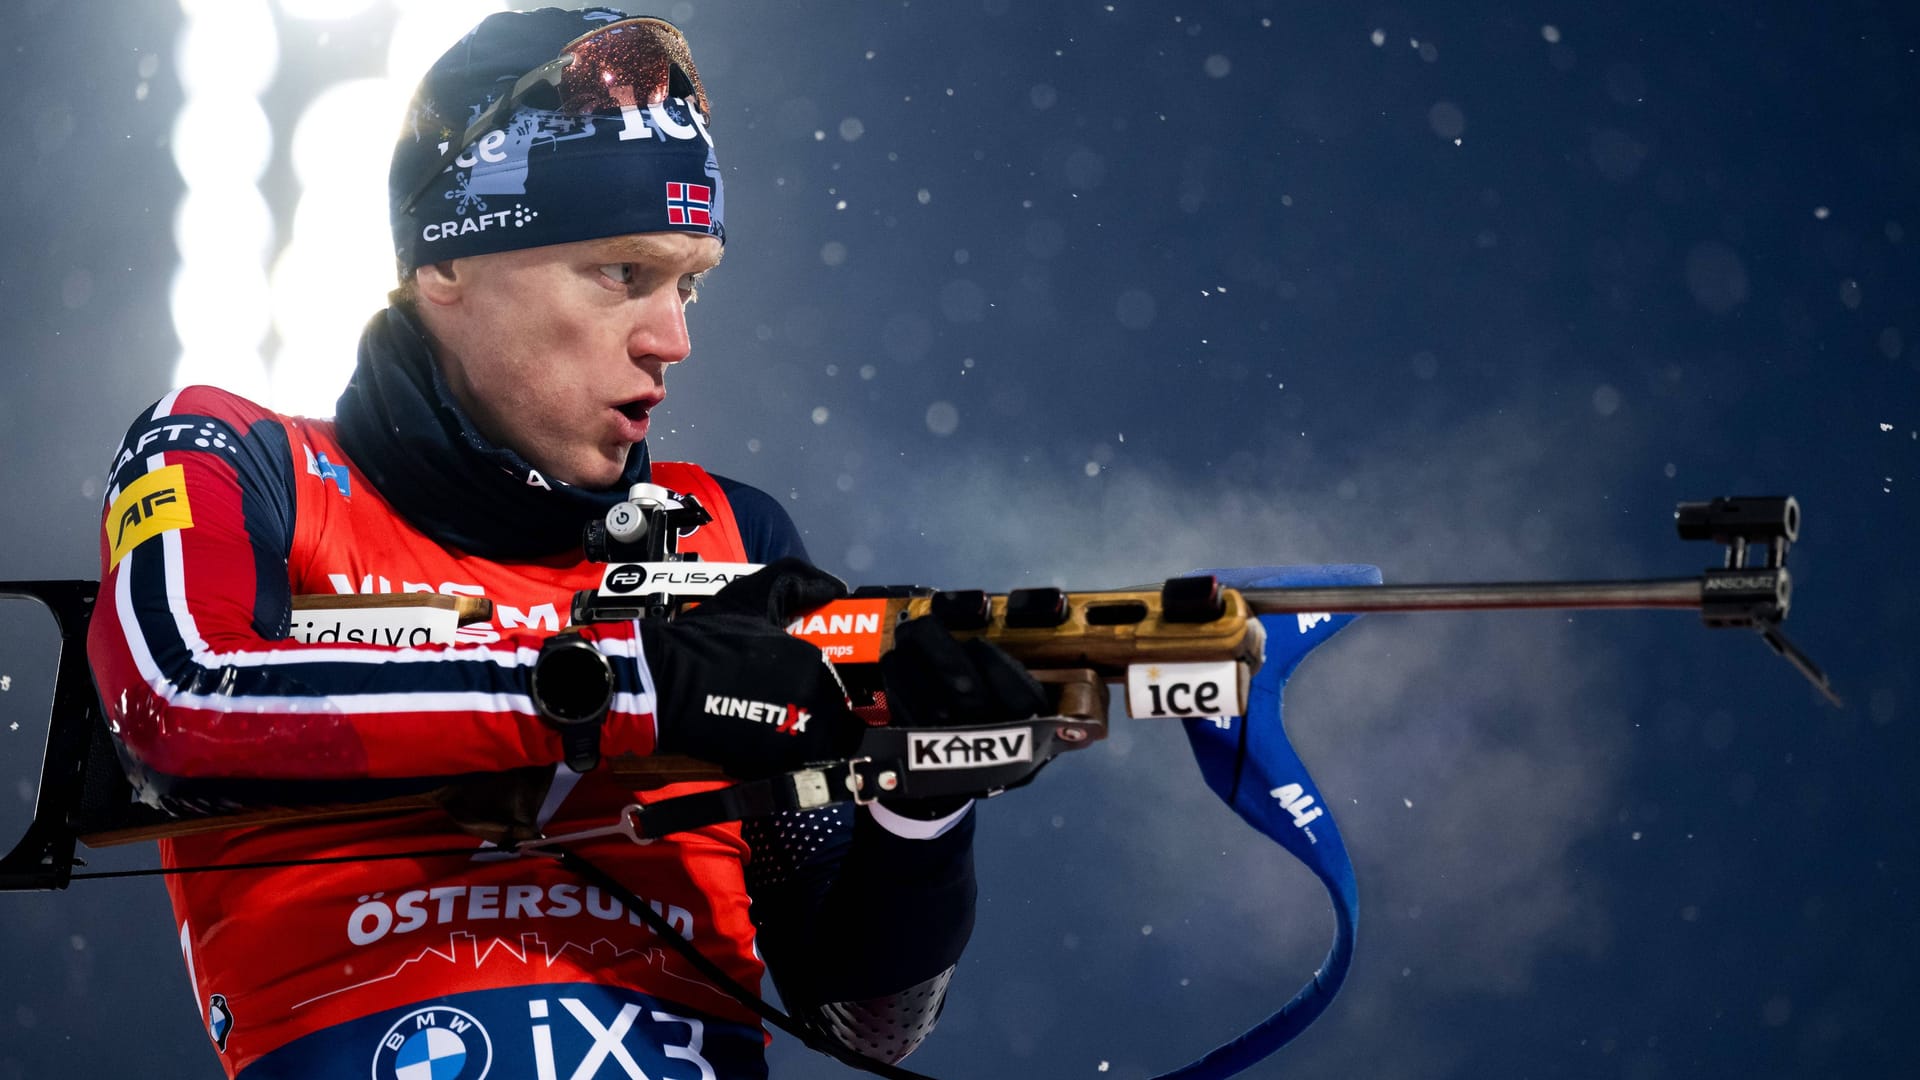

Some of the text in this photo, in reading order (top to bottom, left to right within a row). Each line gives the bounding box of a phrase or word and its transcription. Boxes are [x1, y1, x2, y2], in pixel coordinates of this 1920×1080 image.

[423, 210, 511, 241] CRAFT
[106, 424, 195, 490] AFT
[115, 488, 177, 551] AF
[651, 572, 749, 584] FLISA
[291, 622, 432, 647] idsiva
[1148, 668, 1221, 716] ice
[386, 1012, 472, 1051] BMW
[529, 998, 717, 1080] iX3
